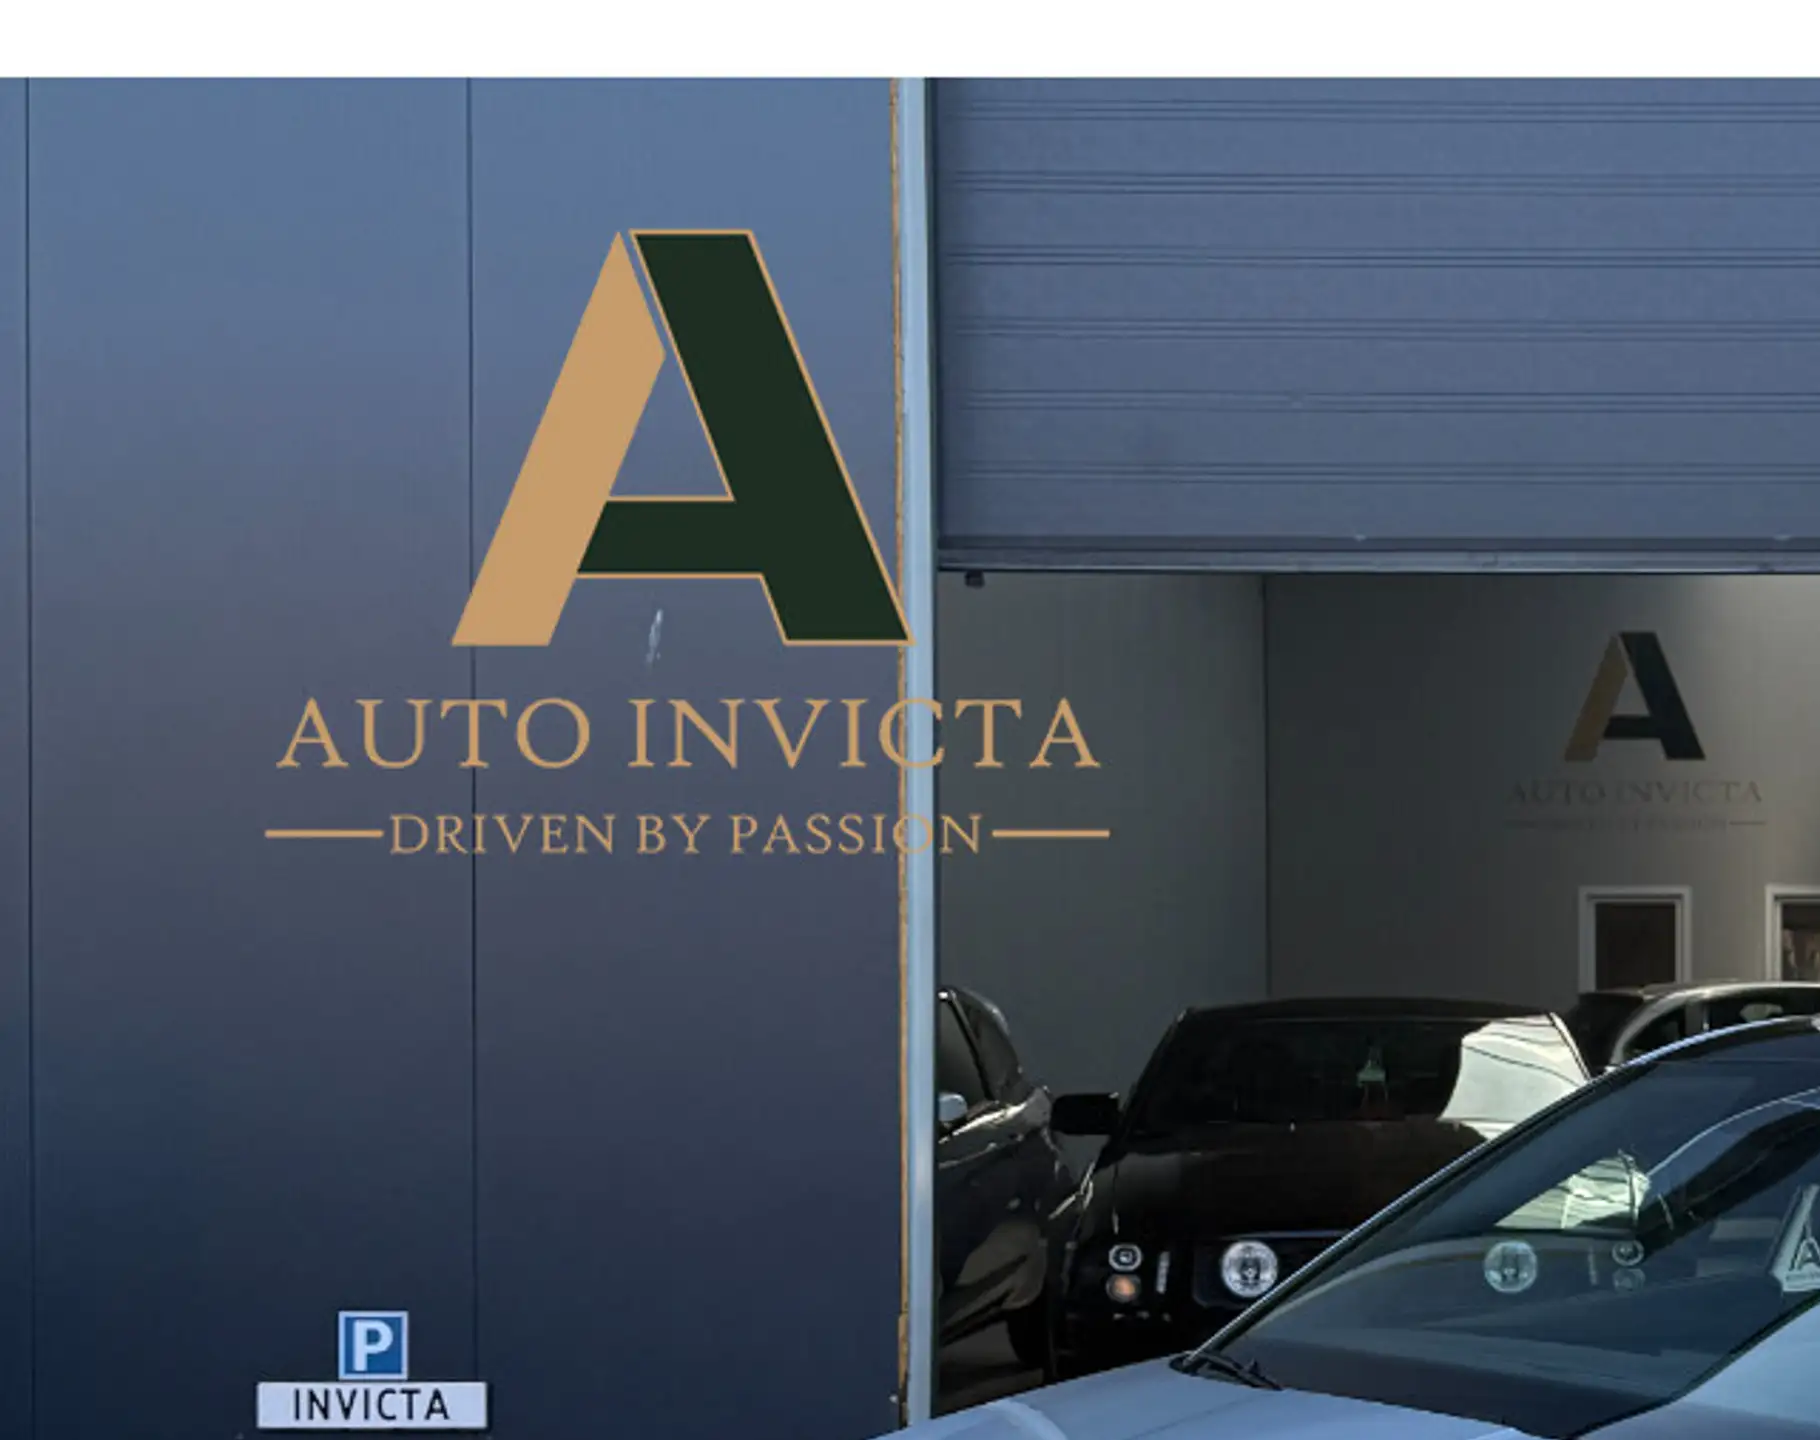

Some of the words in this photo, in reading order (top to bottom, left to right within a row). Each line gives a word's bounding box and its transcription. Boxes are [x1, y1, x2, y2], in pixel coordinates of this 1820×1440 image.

[1615, 780, 1764, 804] INVICTA
[353, 1320, 393, 1371] P
[294, 1388, 450, 1421] INVICTA
